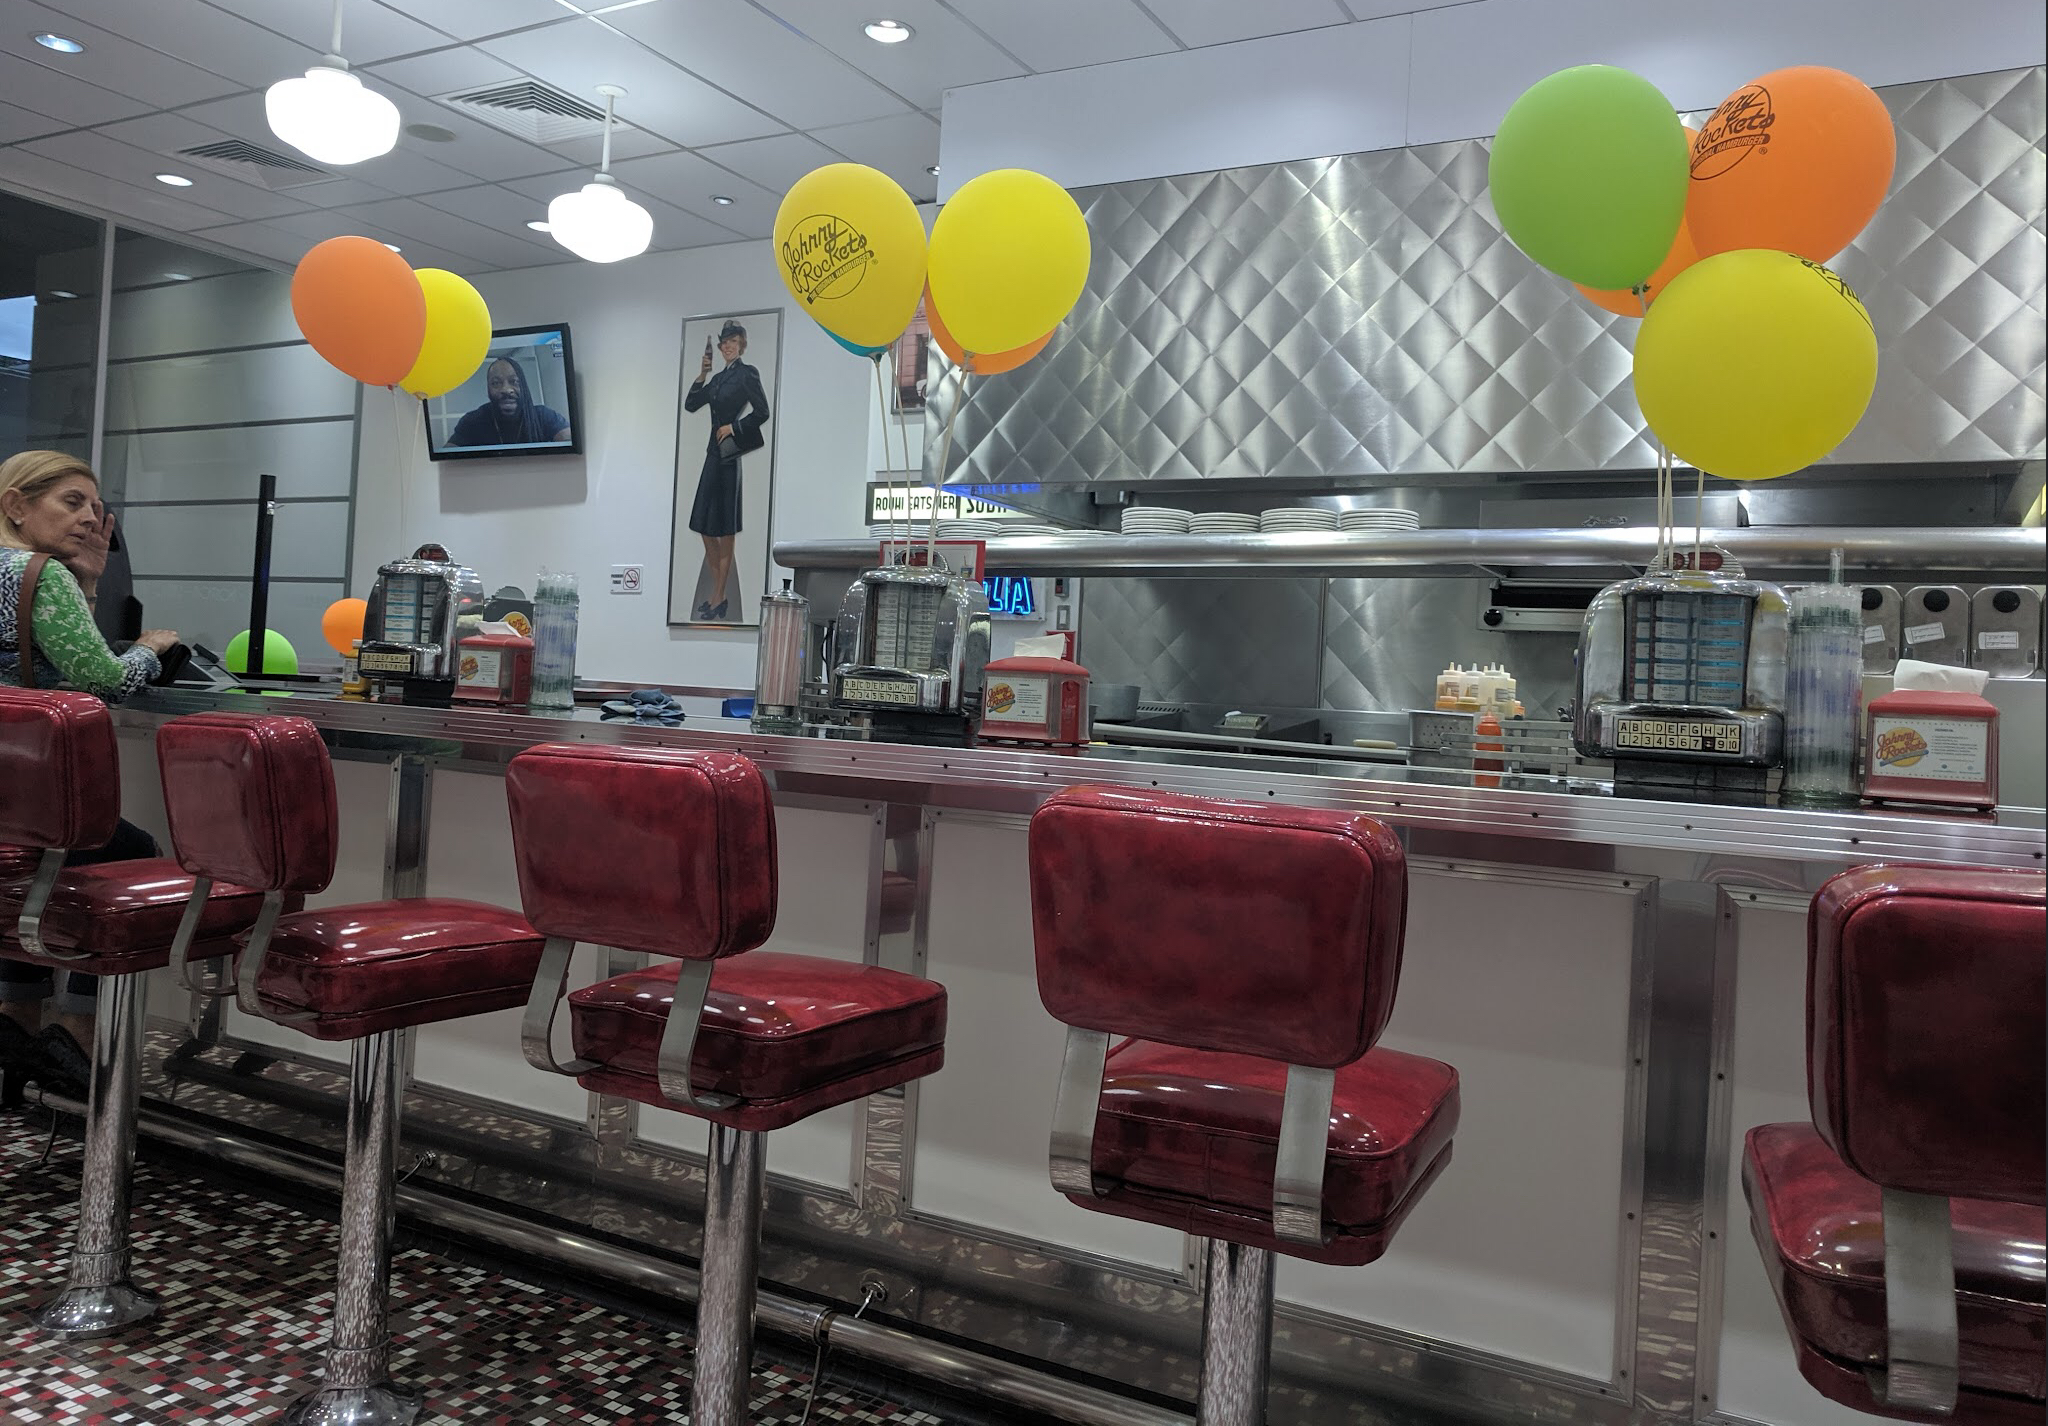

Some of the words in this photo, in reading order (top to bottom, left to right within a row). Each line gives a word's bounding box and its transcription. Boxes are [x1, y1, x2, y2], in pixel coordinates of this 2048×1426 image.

[1716, 135, 1764, 155] HAMBURGER
[783, 217, 848, 293] Johnny
[793, 234, 867, 293] Rockets
[1876, 731, 1919, 759] Johnny
[1882, 739, 1927, 760] Rockets
